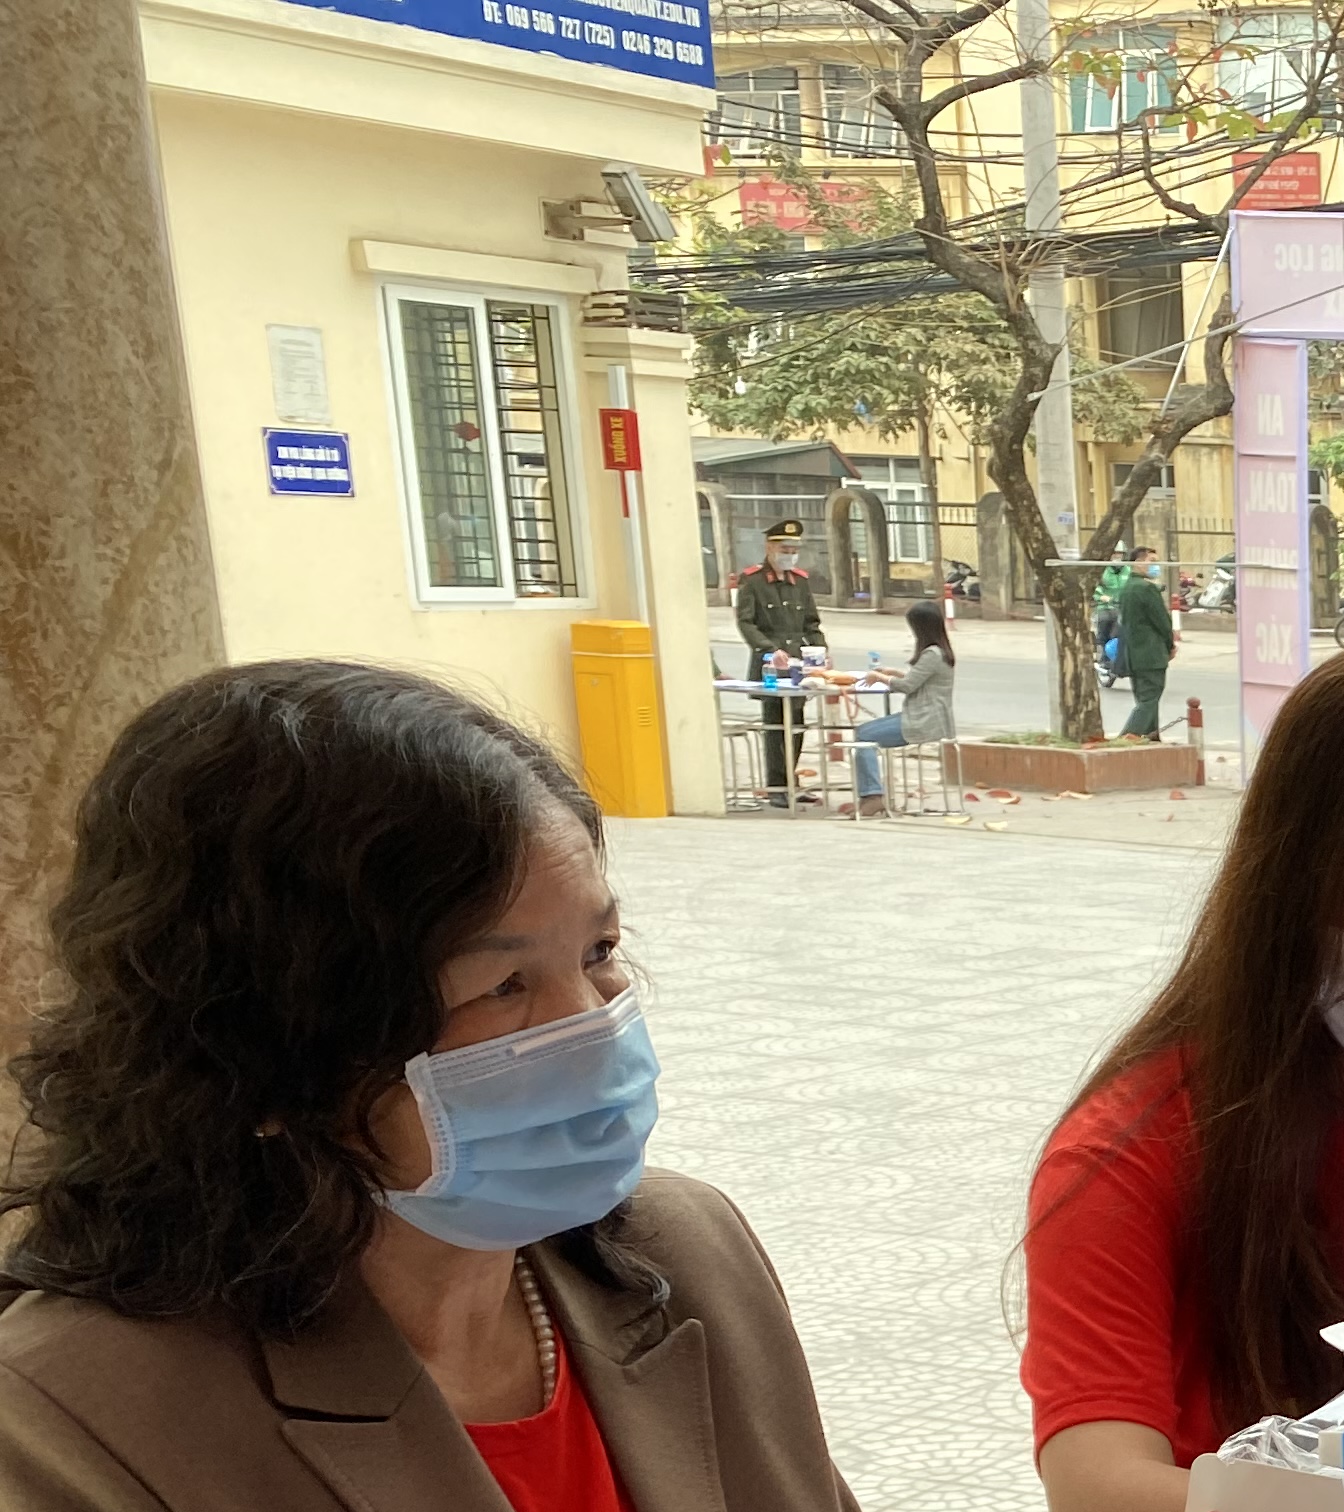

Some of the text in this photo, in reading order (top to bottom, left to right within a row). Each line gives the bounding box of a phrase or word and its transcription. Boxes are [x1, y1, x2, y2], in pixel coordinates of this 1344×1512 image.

[504, 4, 530, 30] 069
[531, 9, 555, 35] 566
[558, 16, 582, 40] 727
[583, 21, 616, 49] (725)
[621, 29, 652, 55] 0246
[653, 36, 675, 60] 329
[675, 41, 704, 66] 6588
[609, 416, 624, 429] XE
